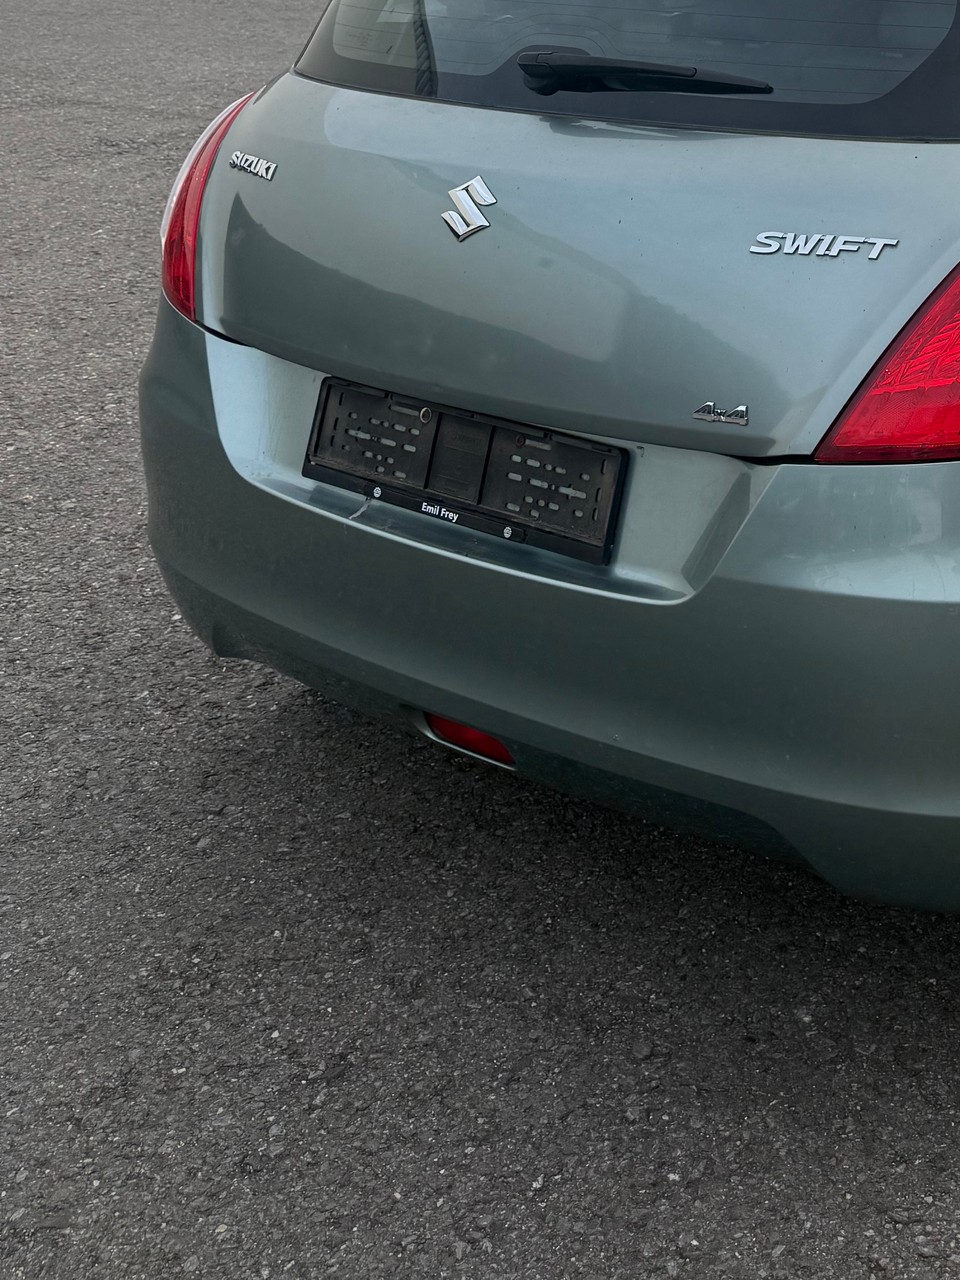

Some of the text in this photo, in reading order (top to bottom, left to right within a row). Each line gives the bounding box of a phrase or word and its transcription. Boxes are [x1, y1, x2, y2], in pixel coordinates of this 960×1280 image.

[229, 150, 277, 181] SUZUKI
[750, 231, 899, 260] SWIFT
[421, 502, 459, 523] Emil Frey
